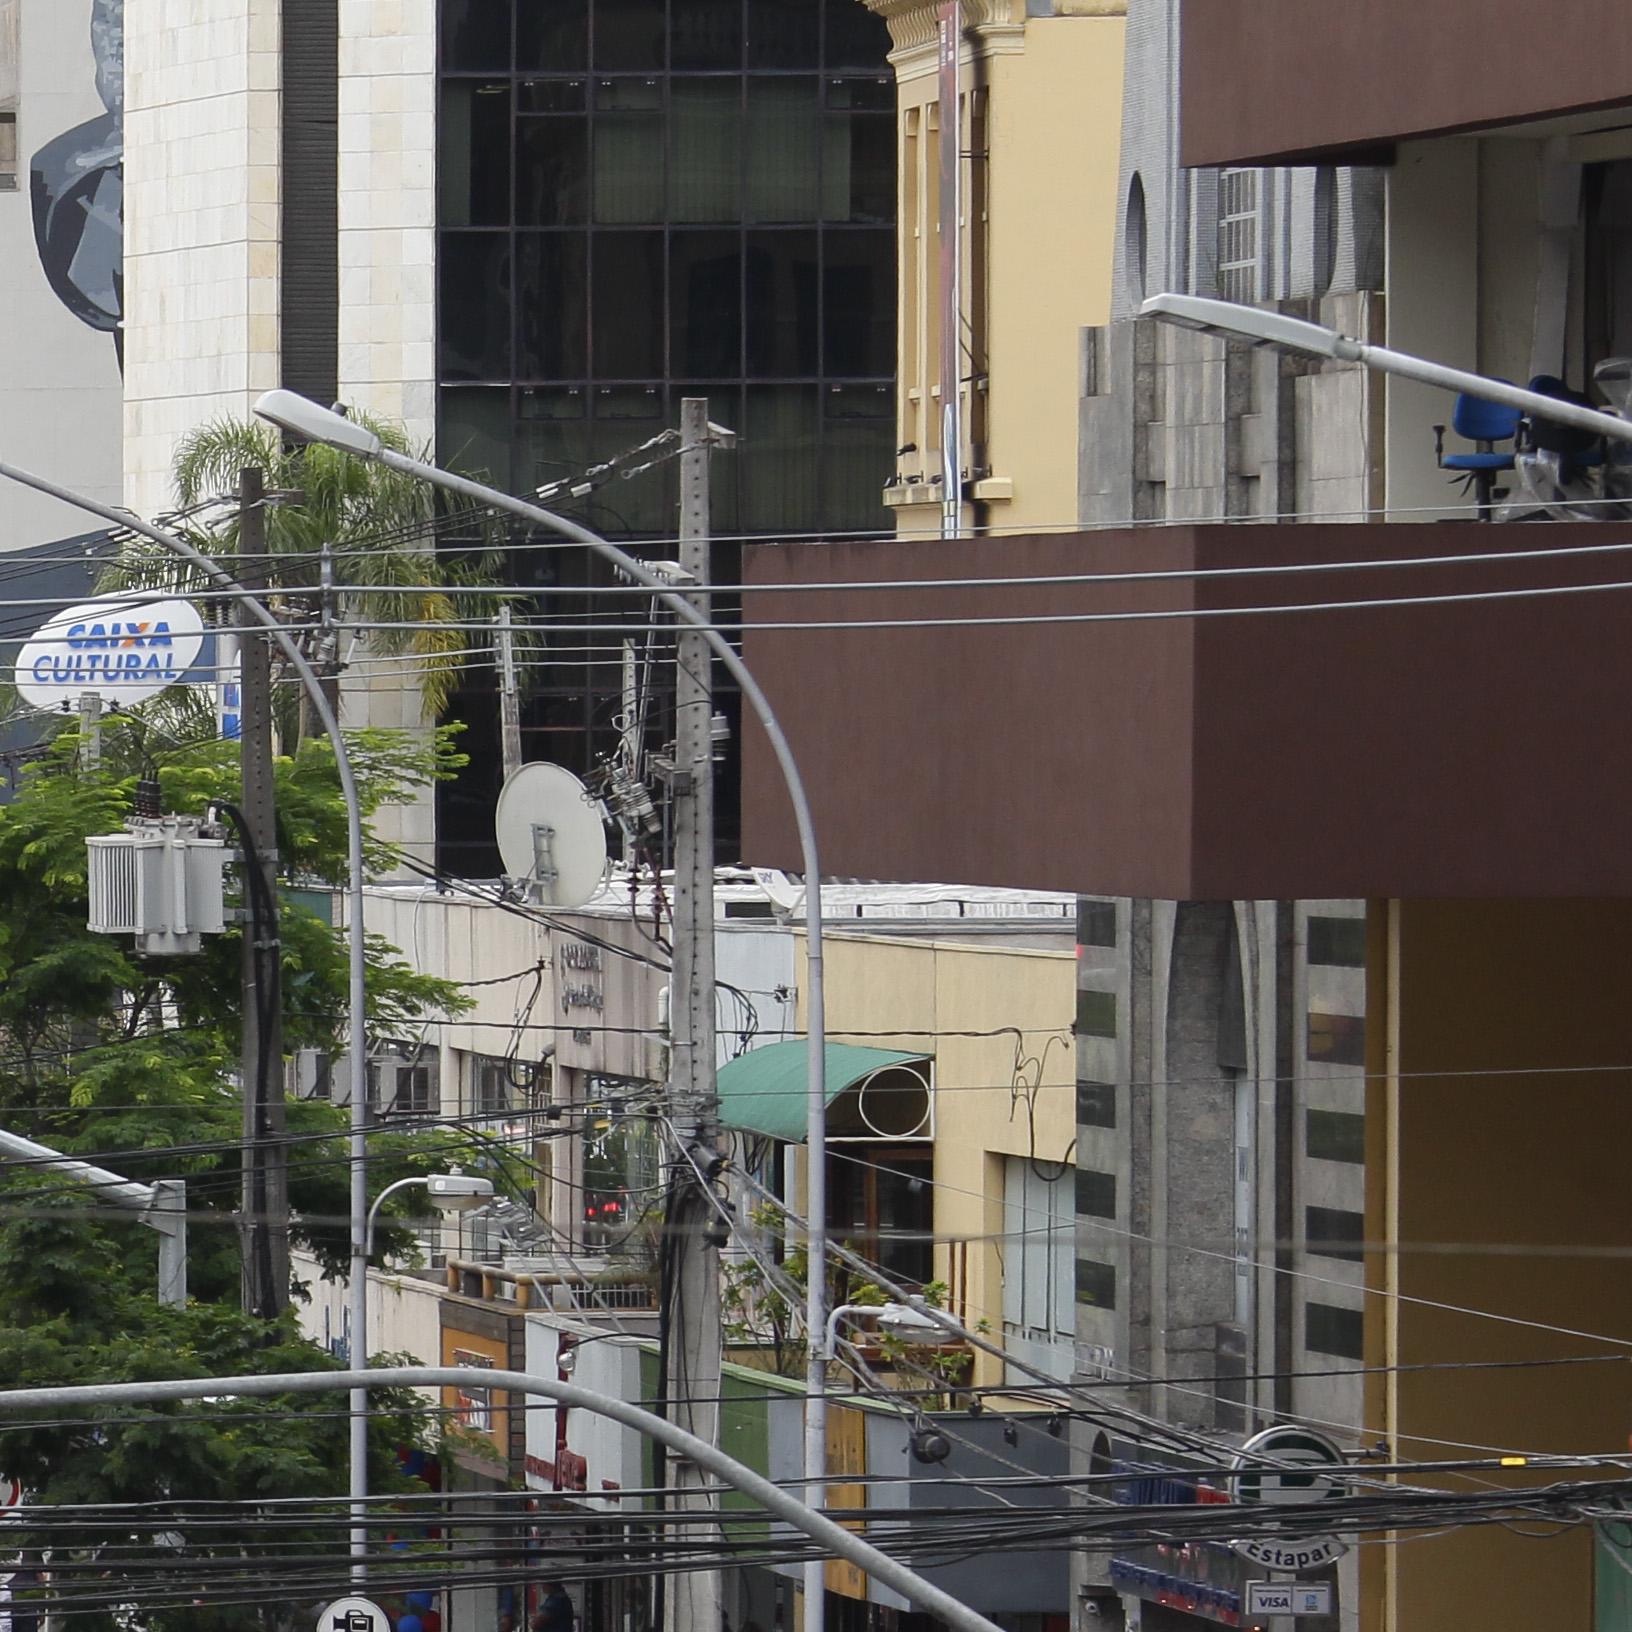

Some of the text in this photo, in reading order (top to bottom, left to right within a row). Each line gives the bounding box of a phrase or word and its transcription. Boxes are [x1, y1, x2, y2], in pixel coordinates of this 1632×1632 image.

[67, 620, 173, 650] CAIXA
[33, 648, 177, 683] CULTURAL
[1245, 1541, 1332, 1570] Estapar
[1258, 1595, 1290, 1608] VISA
